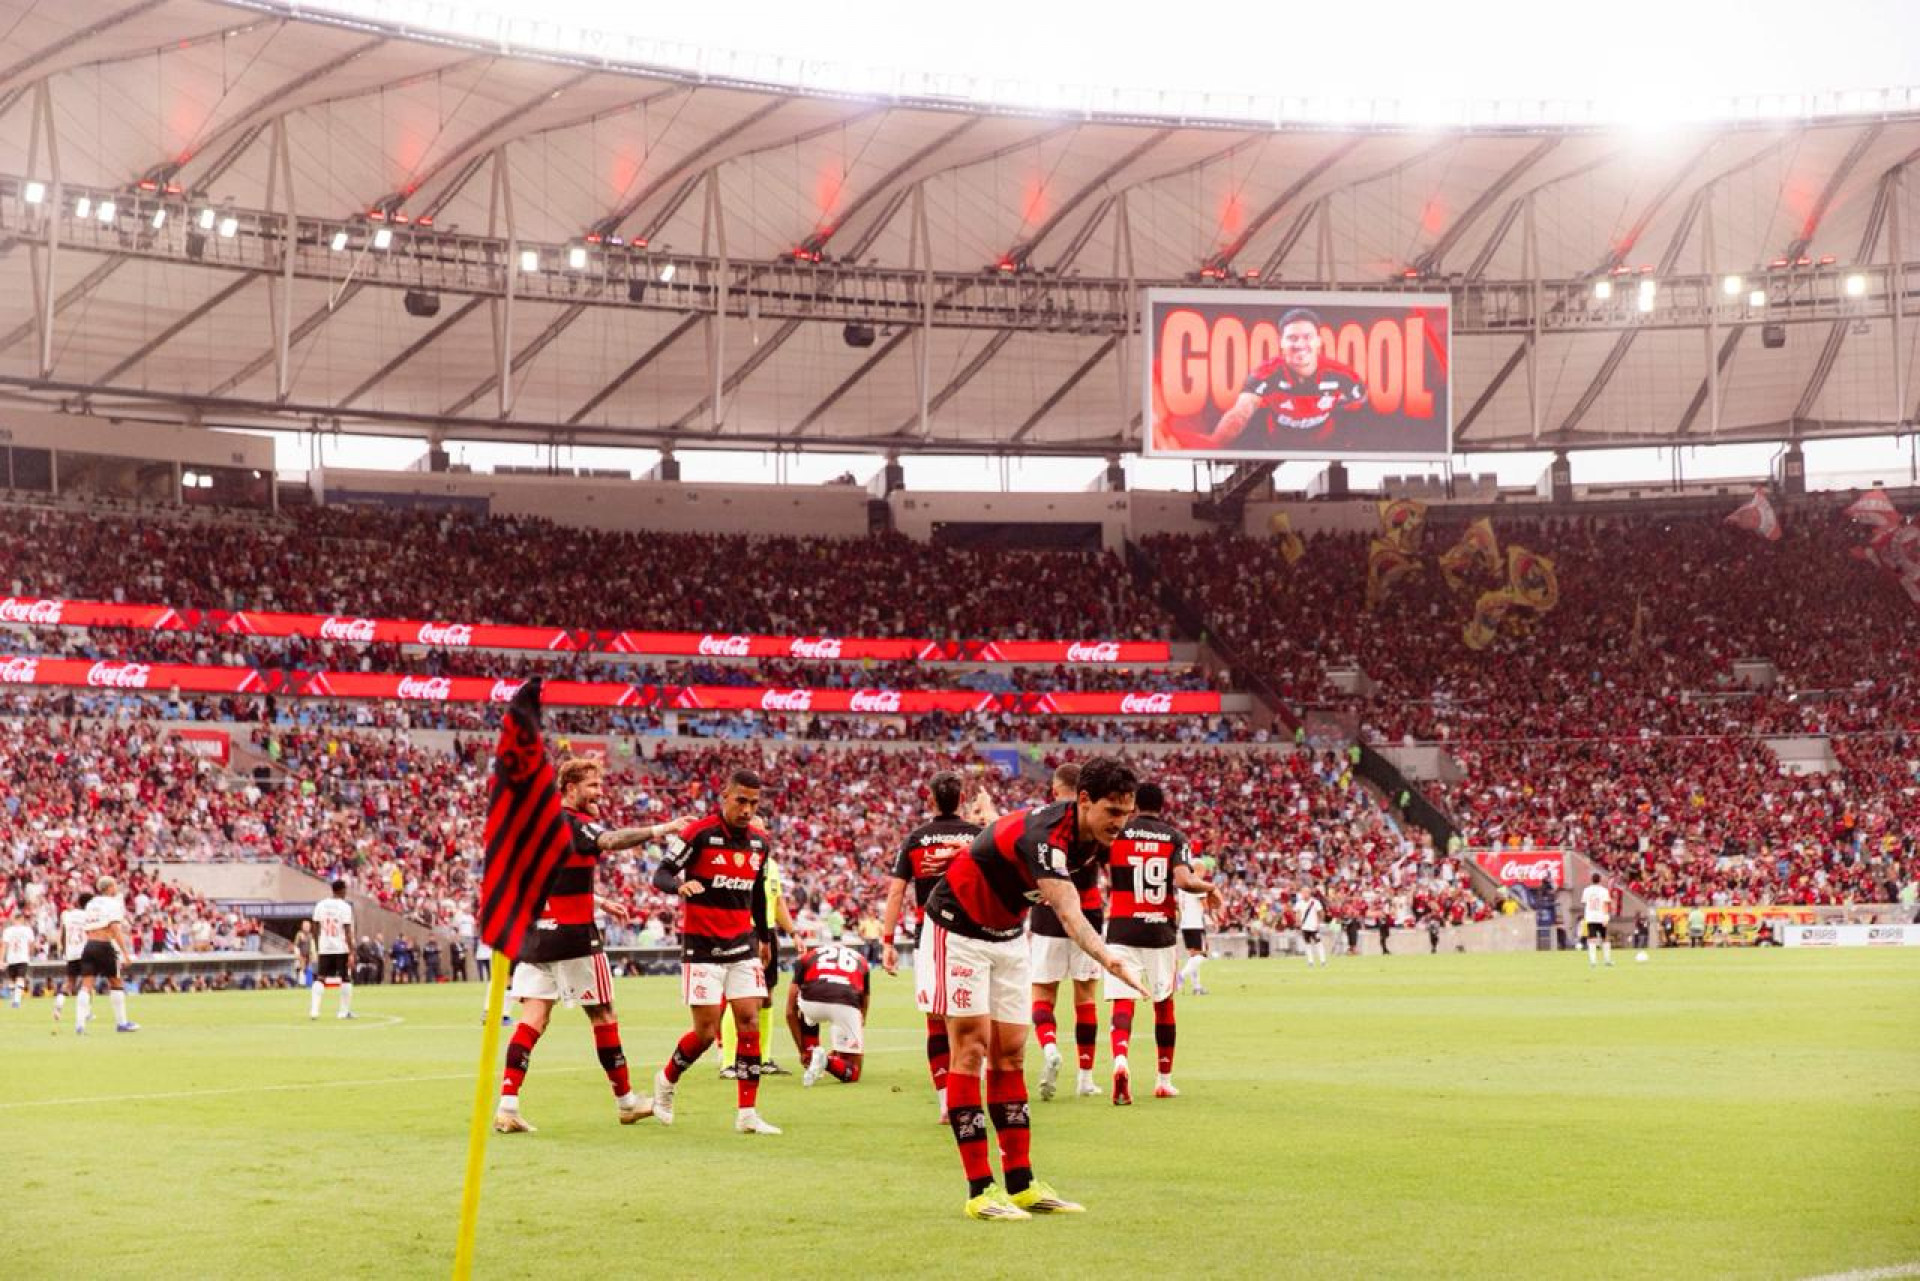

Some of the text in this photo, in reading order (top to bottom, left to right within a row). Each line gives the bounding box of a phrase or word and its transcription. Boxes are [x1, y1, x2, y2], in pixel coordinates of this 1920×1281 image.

[711, 875, 754, 890] Betan
[1127, 856, 1168, 904] 19
[816, 945, 859, 972] 26
